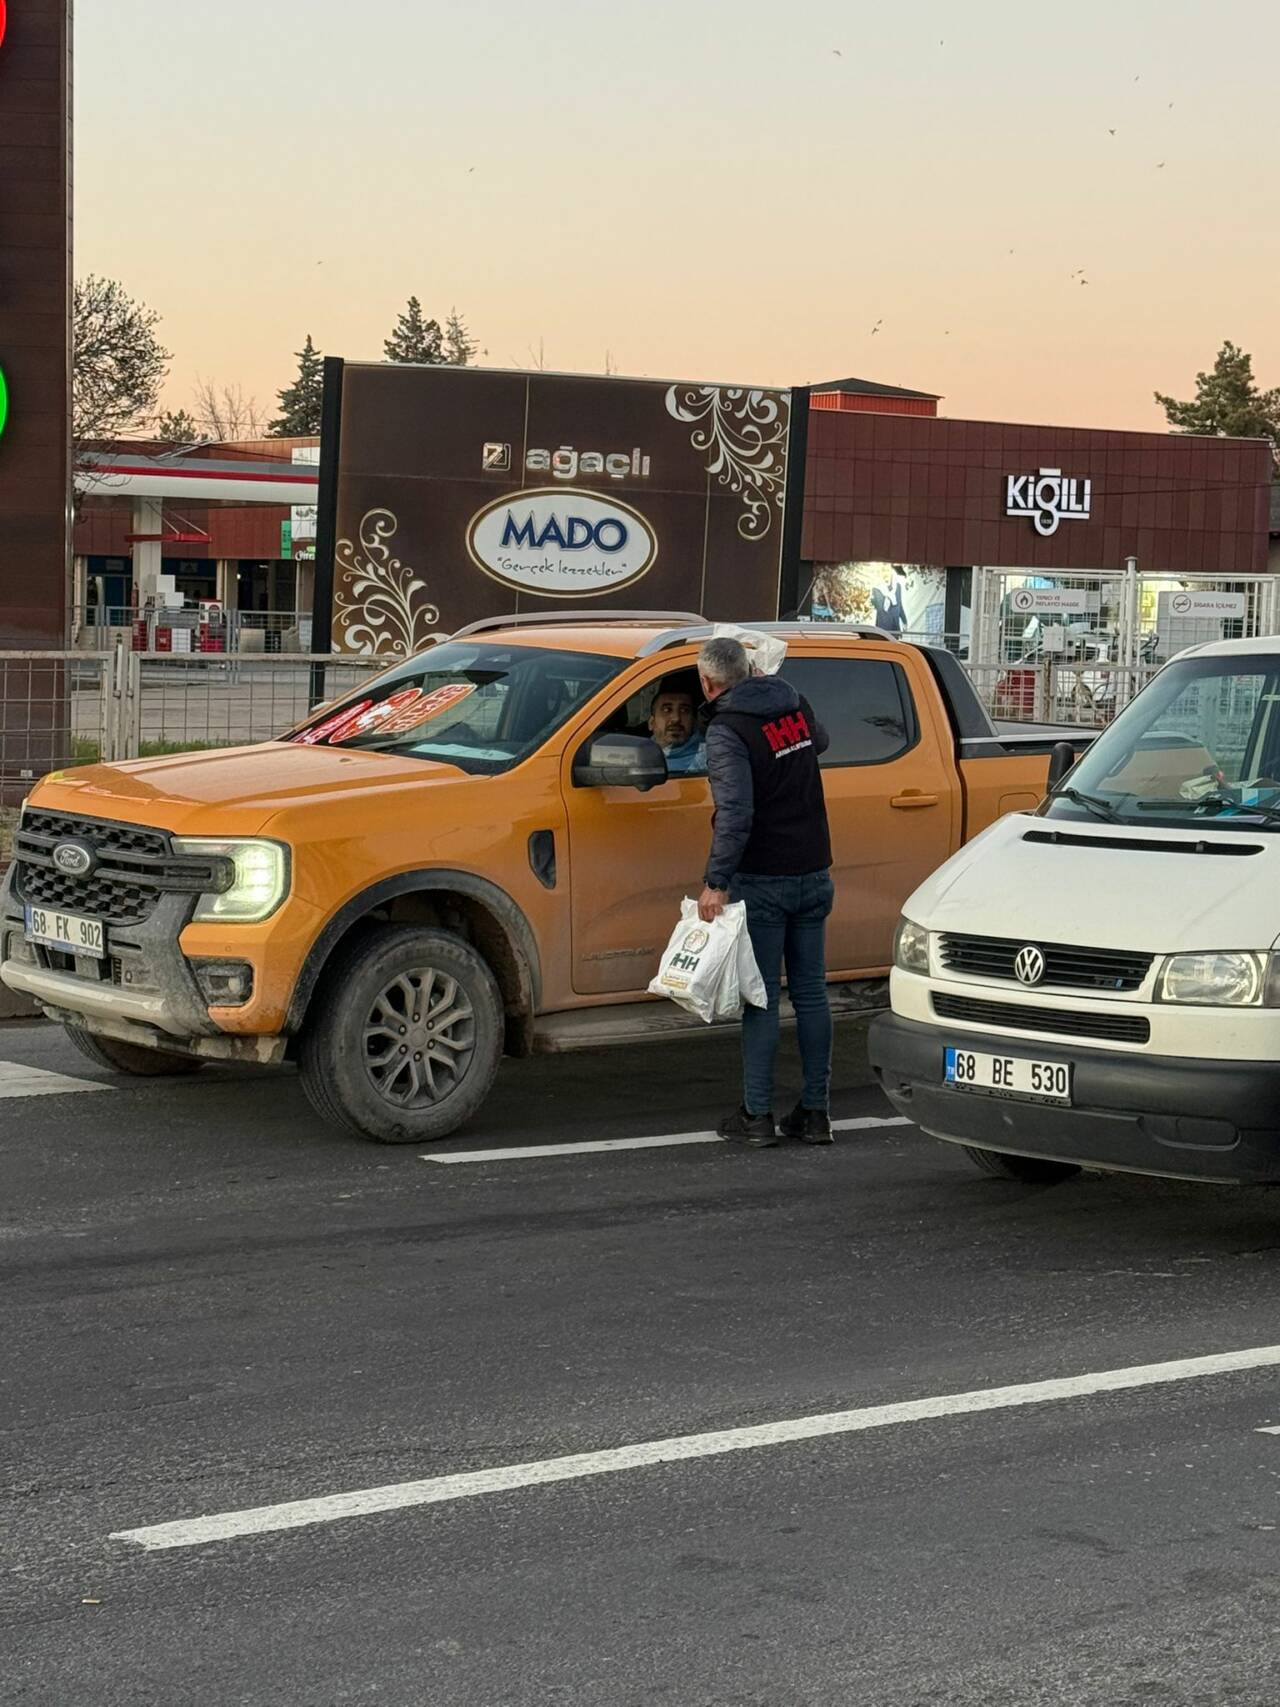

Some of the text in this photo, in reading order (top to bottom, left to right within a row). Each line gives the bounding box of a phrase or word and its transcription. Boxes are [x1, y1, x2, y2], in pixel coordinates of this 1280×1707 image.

[526, 446, 650, 479] ağaçlı
[501, 510, 628, 553] MADO
[32, 910, 46, 934] 68
[55, 915, 70, 941] FK
[80, 921, 102, 948] 902
[956, 1053, 1066, 1093] 68 BE 530
